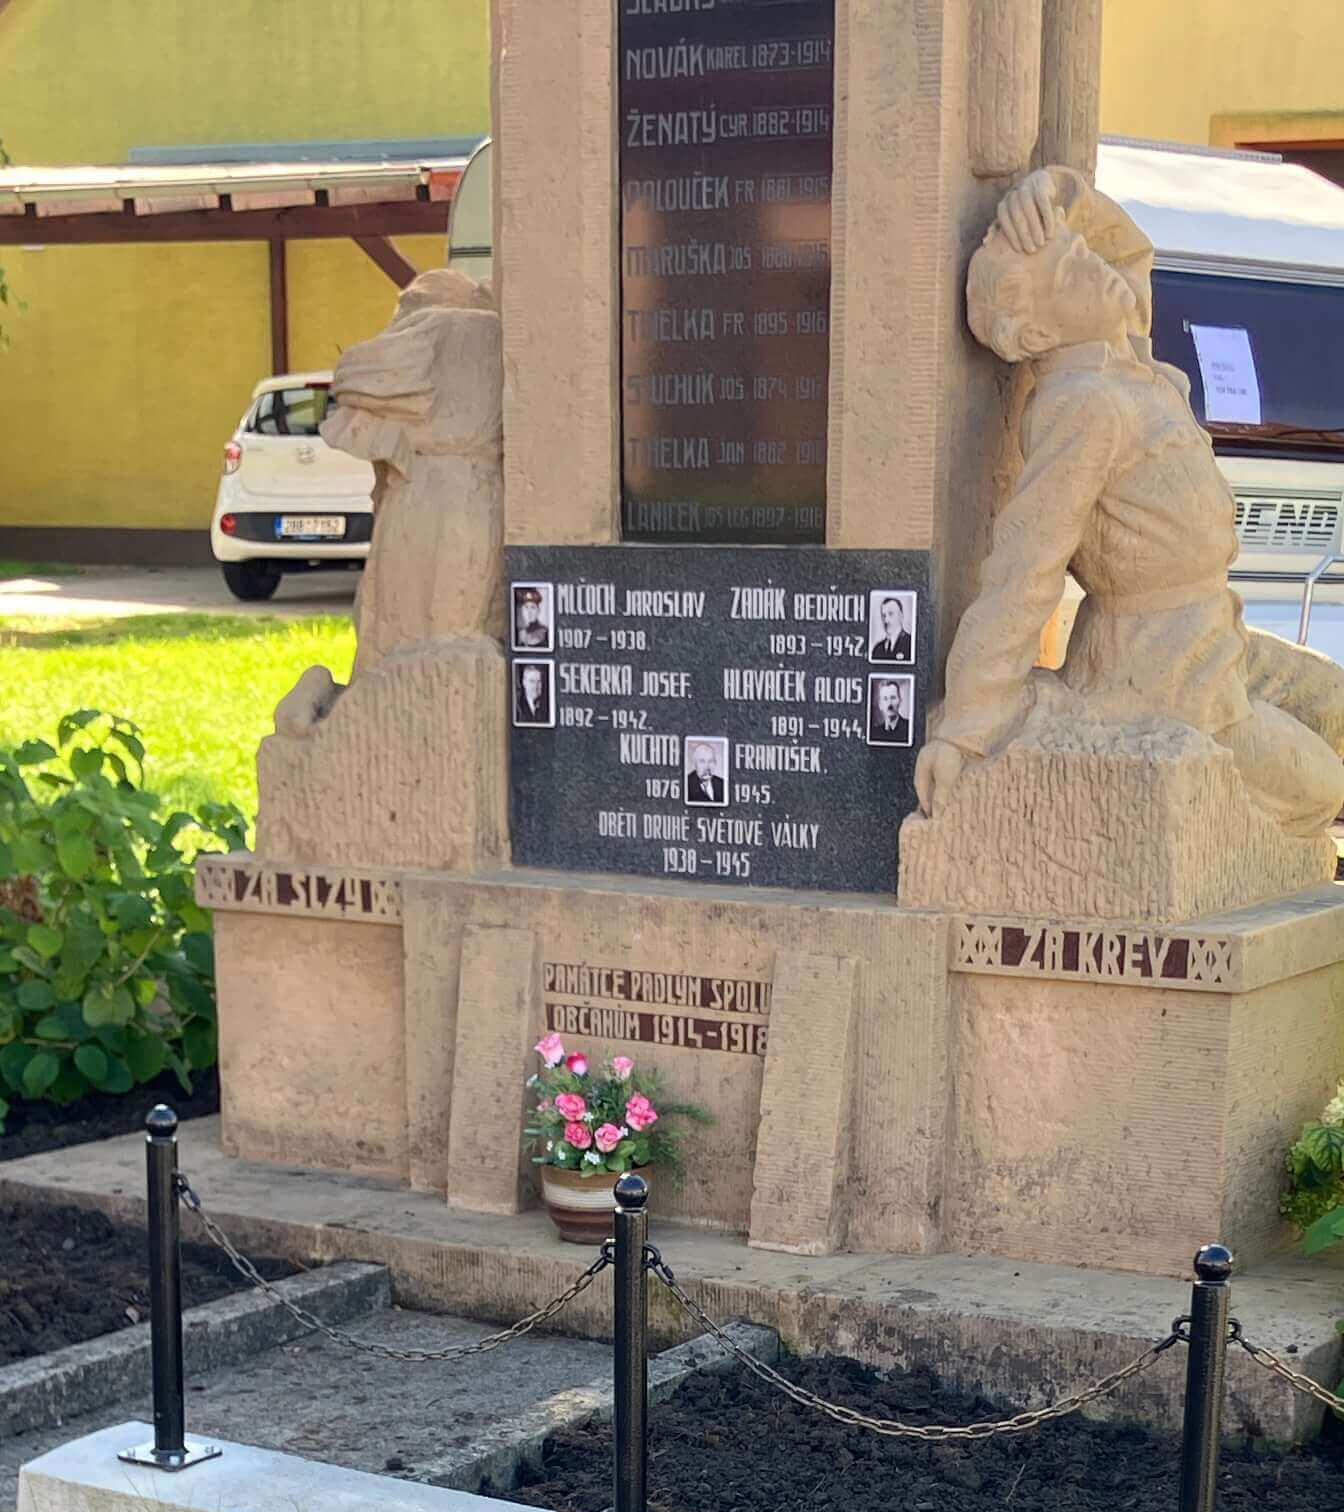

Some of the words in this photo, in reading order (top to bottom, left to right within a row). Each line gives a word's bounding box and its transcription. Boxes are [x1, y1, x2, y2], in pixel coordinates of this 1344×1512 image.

[625, 38, 704, 80] NOVÁK
[706, 45, 748, 71] KAREL
[626, 104, 717, 148] ŽENATÝ
[558, 577, 616, 616] MLČOCH
[623, 590, 705, 618] JAROSLAV
[730, 578, 786, 620] ZADÁK
[794, 585, 865, 622] BEDŘICH
[558, 628, 592, 649] 1907
[770, 634, 806, 655] 1893
[559, 662, 632, 696] SEKERKA
[814, 676, 863, 703] ALOIS
[559, 707, 594, 727] 1892
[771, 716, 804, 737] 1891
[620, 733, 680, 766] KUCHTA
[646, 779, 680, 799] 1876
[599, 807, 636, 838] OBĚTI
[644, 809, 689, 842] DRUHÉ
[698, 811, 763, 845] SVĚTOVÉ
[771, 813, 819, 849] VÁLKY
[663, 848, 697, 874] 1938
[716, 851, 750, 877] 1945
[1017, 925, 1064, 972] ZA
[1077, 931, 1172, 979] KREV
[544, 960, 626, 1000] PAMÁTCE
[709, 979, 772, 1014] SPOLU
[553, 1001, 641, 1041] OBČANŮM
